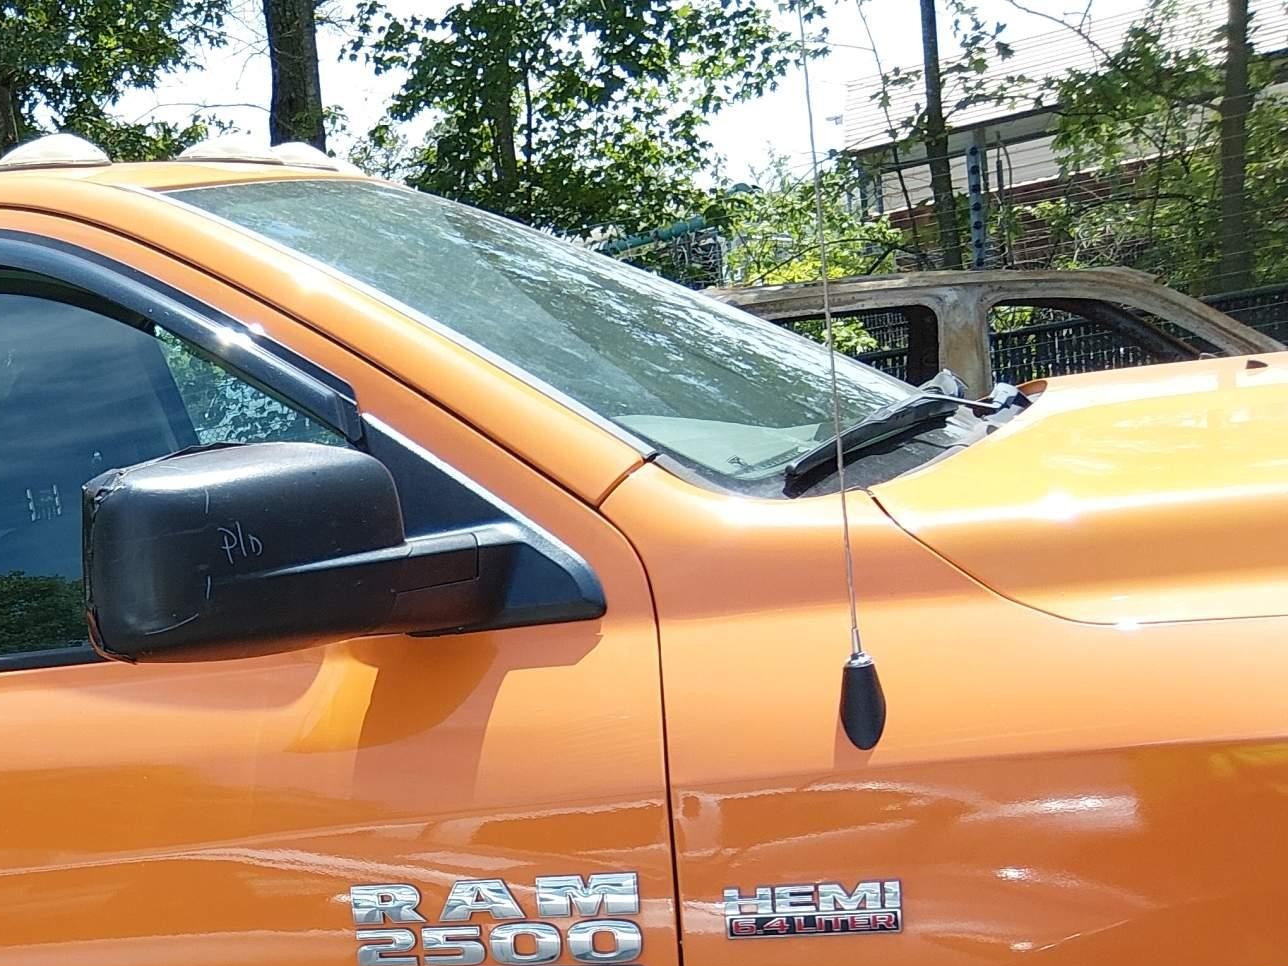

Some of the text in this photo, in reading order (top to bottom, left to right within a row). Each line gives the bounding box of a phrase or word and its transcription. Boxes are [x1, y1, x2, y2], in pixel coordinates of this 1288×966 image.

[351, 872, 640, 925] RAM
[723, 880, 902, 916] HEMI
[731, 913, 896, 936] 6.4 LITER
